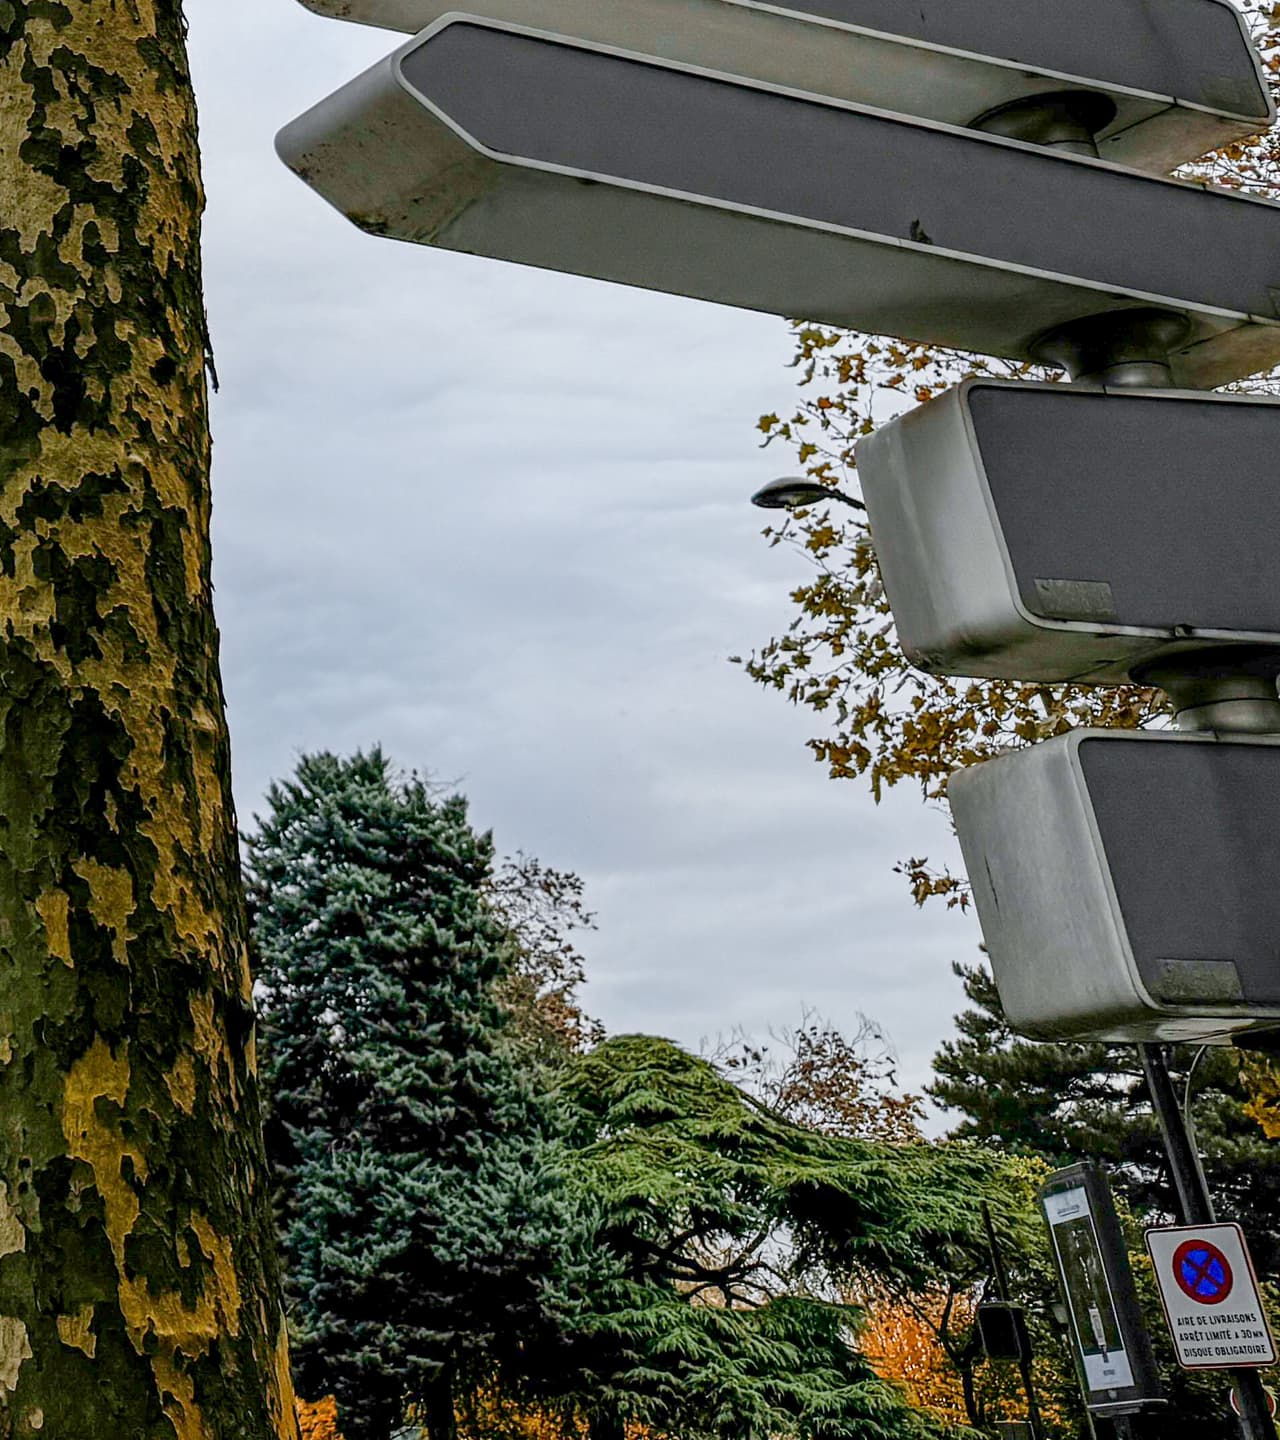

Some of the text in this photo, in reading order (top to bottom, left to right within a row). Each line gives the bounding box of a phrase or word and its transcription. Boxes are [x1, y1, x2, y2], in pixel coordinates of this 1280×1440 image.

[1177, 1313, 1257, 1326] AIRE DE LIVRAISONS
[1179, 1330, 1203, 1341] ARRÊT
[1183, 1344, 1268, 1357] DISQUE OBLIGATOIRE
